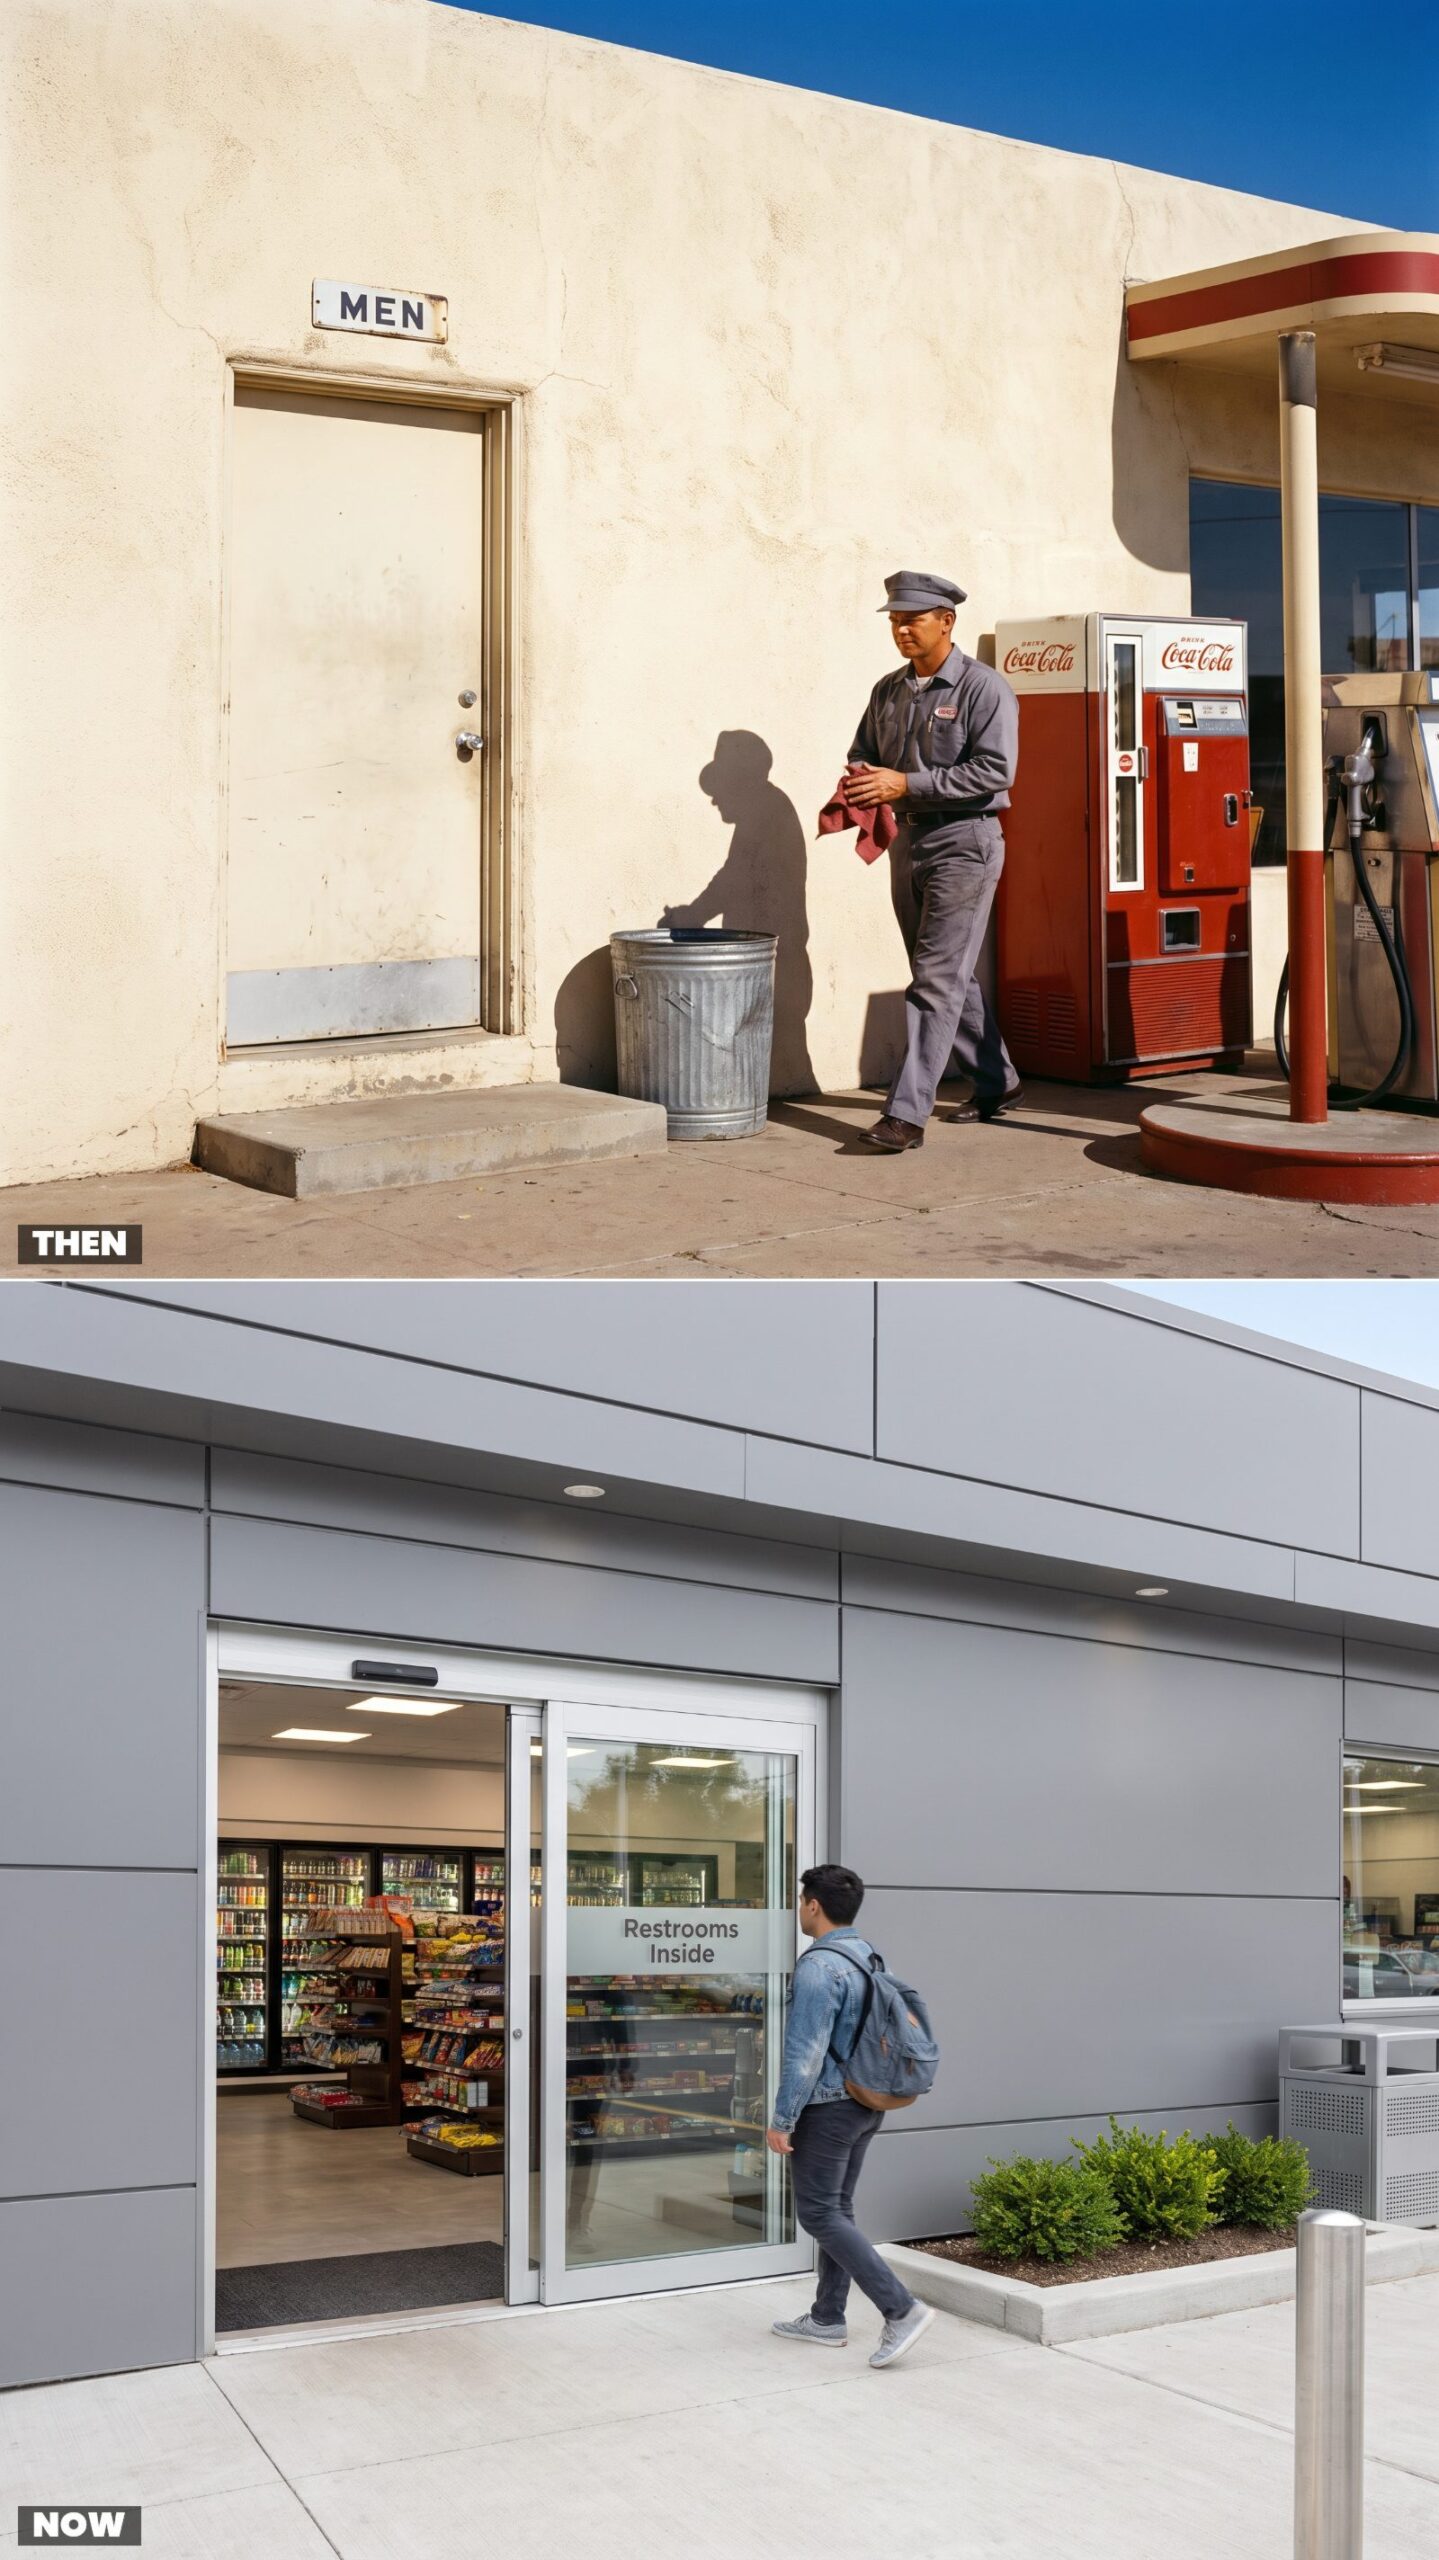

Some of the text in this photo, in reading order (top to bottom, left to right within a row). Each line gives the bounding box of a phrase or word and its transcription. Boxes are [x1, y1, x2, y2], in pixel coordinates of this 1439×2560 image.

[341, 291, 424, 330] MEN
[1004, 644, 1076, 674] Coca-Cola
[1162, 642, 1236, 671] Coca-Cola
[624, 1919, 739, 1938] Restrooms
[651, 1943, 715, 1963] Inside
